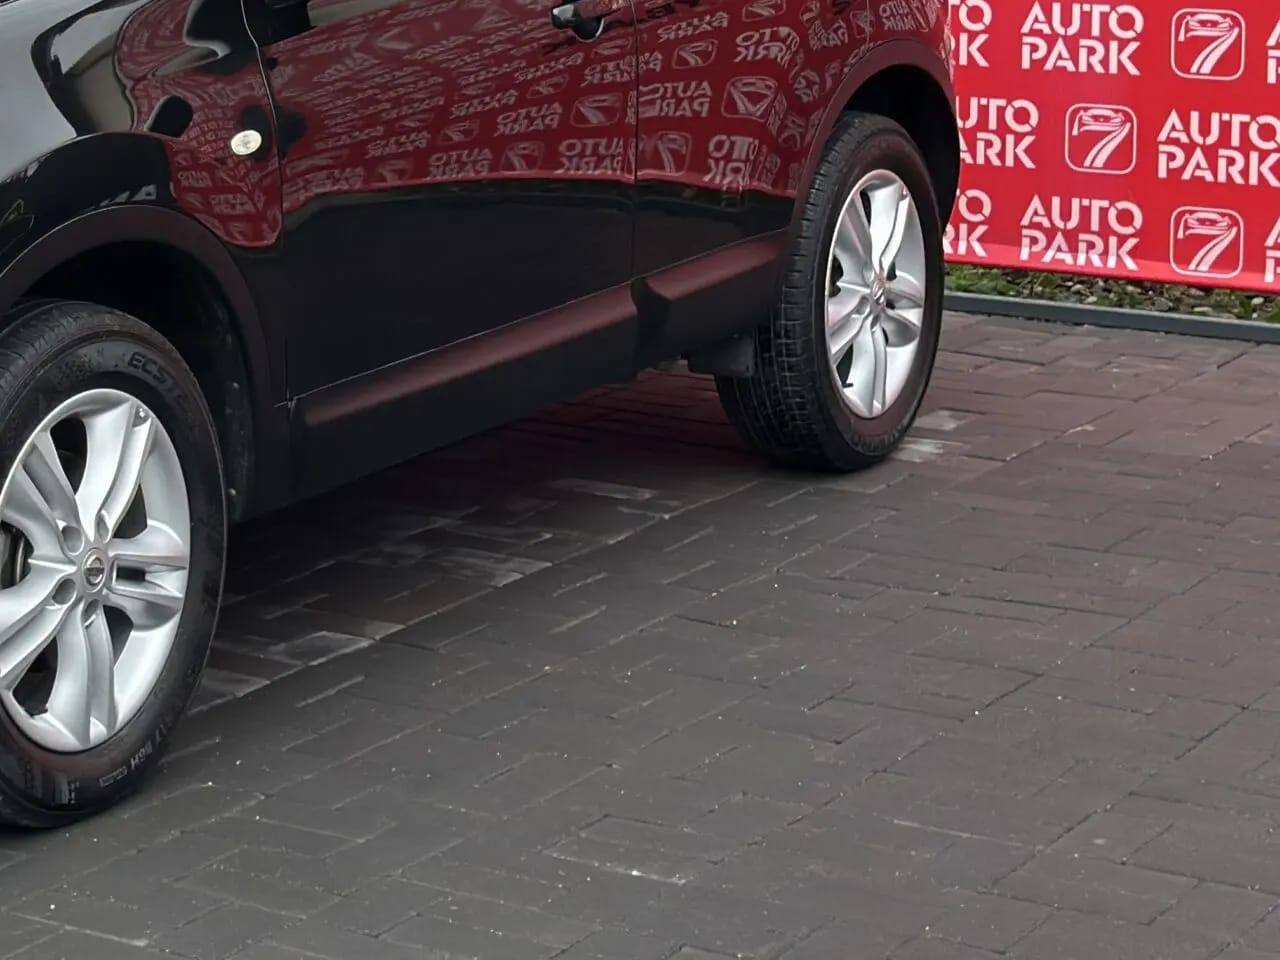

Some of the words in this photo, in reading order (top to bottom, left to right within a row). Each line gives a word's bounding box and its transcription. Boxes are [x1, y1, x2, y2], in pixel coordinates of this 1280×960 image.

[1020, 0, 1144, 39] AUTO
[1021, 35, 1141, 76] PARK
[956, 96, 1039, 133] UTO
[1157, 109, 1280, 150] AUTO
[960, 131, 1037, 168] ARK
[1158, 144, 1280, 187] PARK
[1020, 194, 1143, 235] AUTO
[1020, 228, 1140, 271] PARK
